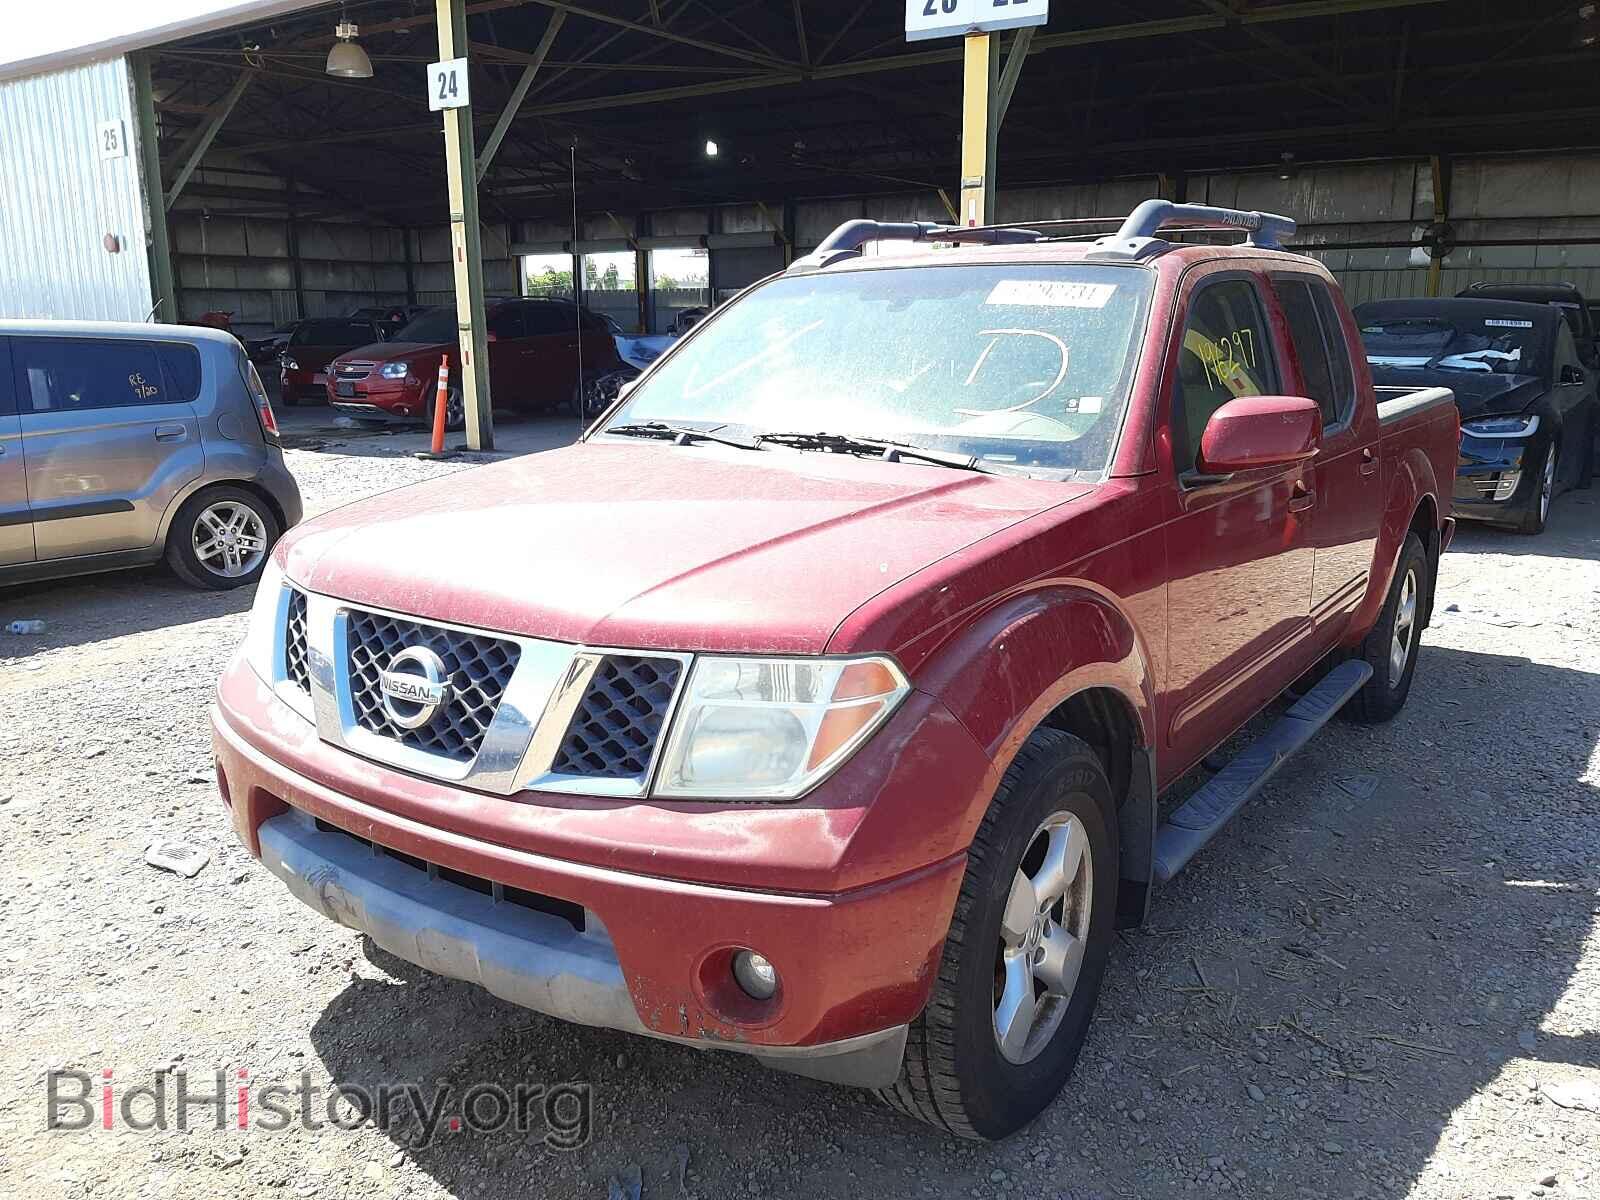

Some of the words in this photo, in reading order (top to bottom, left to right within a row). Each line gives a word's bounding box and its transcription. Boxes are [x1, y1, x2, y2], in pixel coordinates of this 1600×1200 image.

[438, 70, 458, 99] 24
[104, 128, 117, 150] 25
[384, 677, 430, 699] NISSAN
